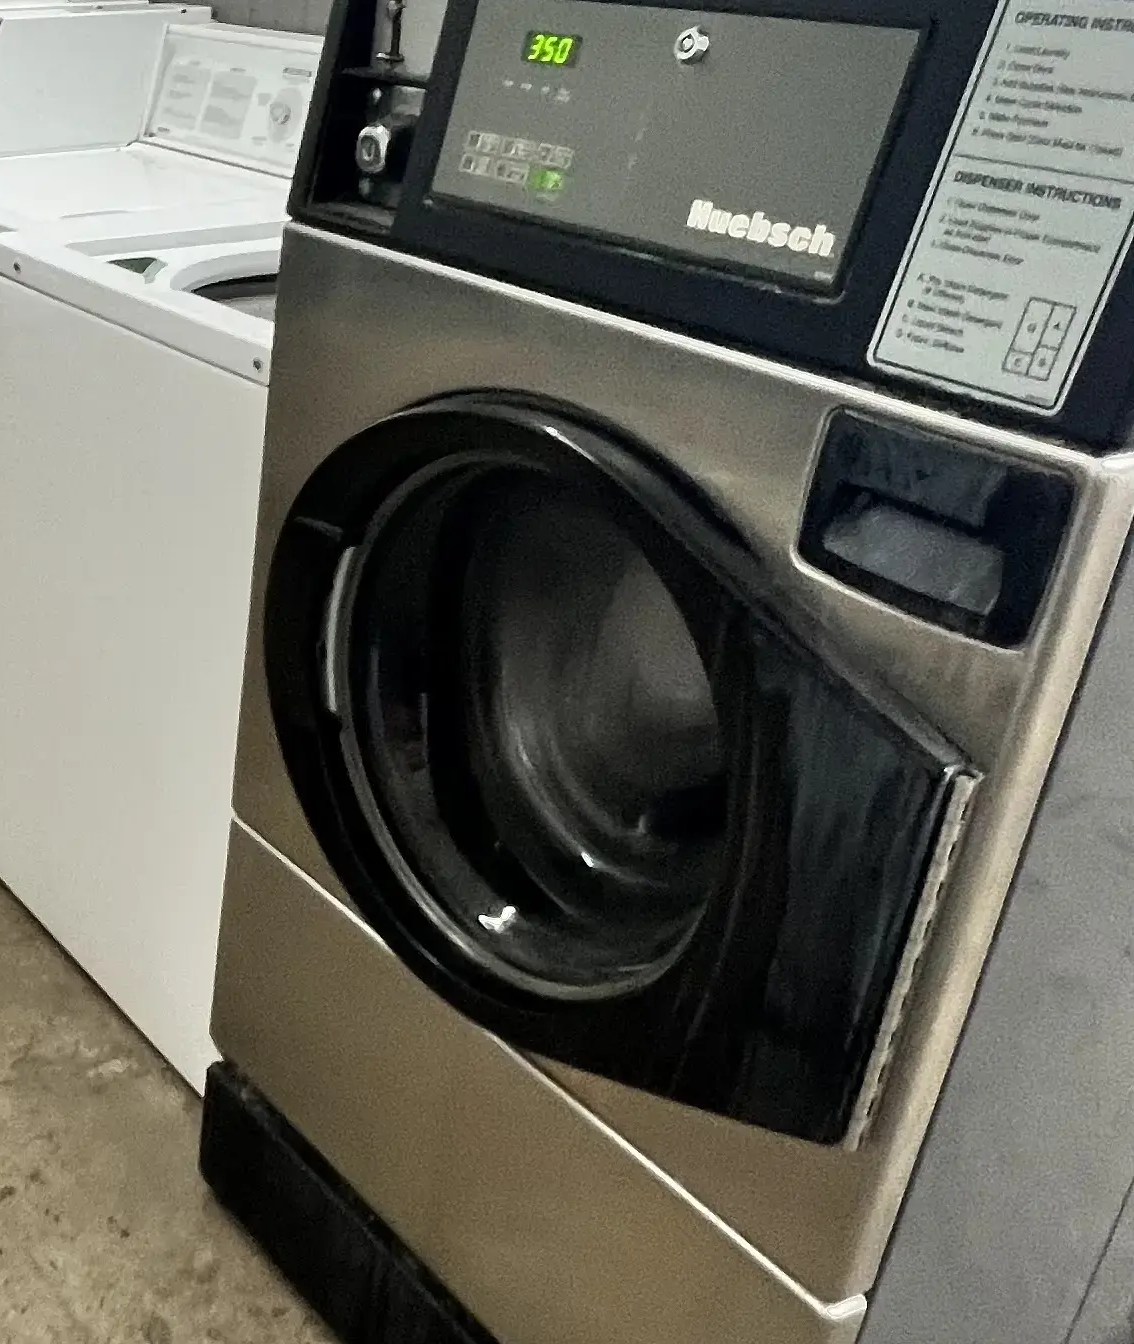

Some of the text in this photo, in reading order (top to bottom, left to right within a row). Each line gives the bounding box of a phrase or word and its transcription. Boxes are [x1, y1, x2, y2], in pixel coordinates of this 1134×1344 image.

[1015, 11, 1089, 29] OPERATING
[528, 34, 574, 64] 350
[954, 171, 1023, 192] DISPENSER
[1024, 182, 1121, 209] INSTRUCTIONS
[686, 199, 836, 257] Huebsch
